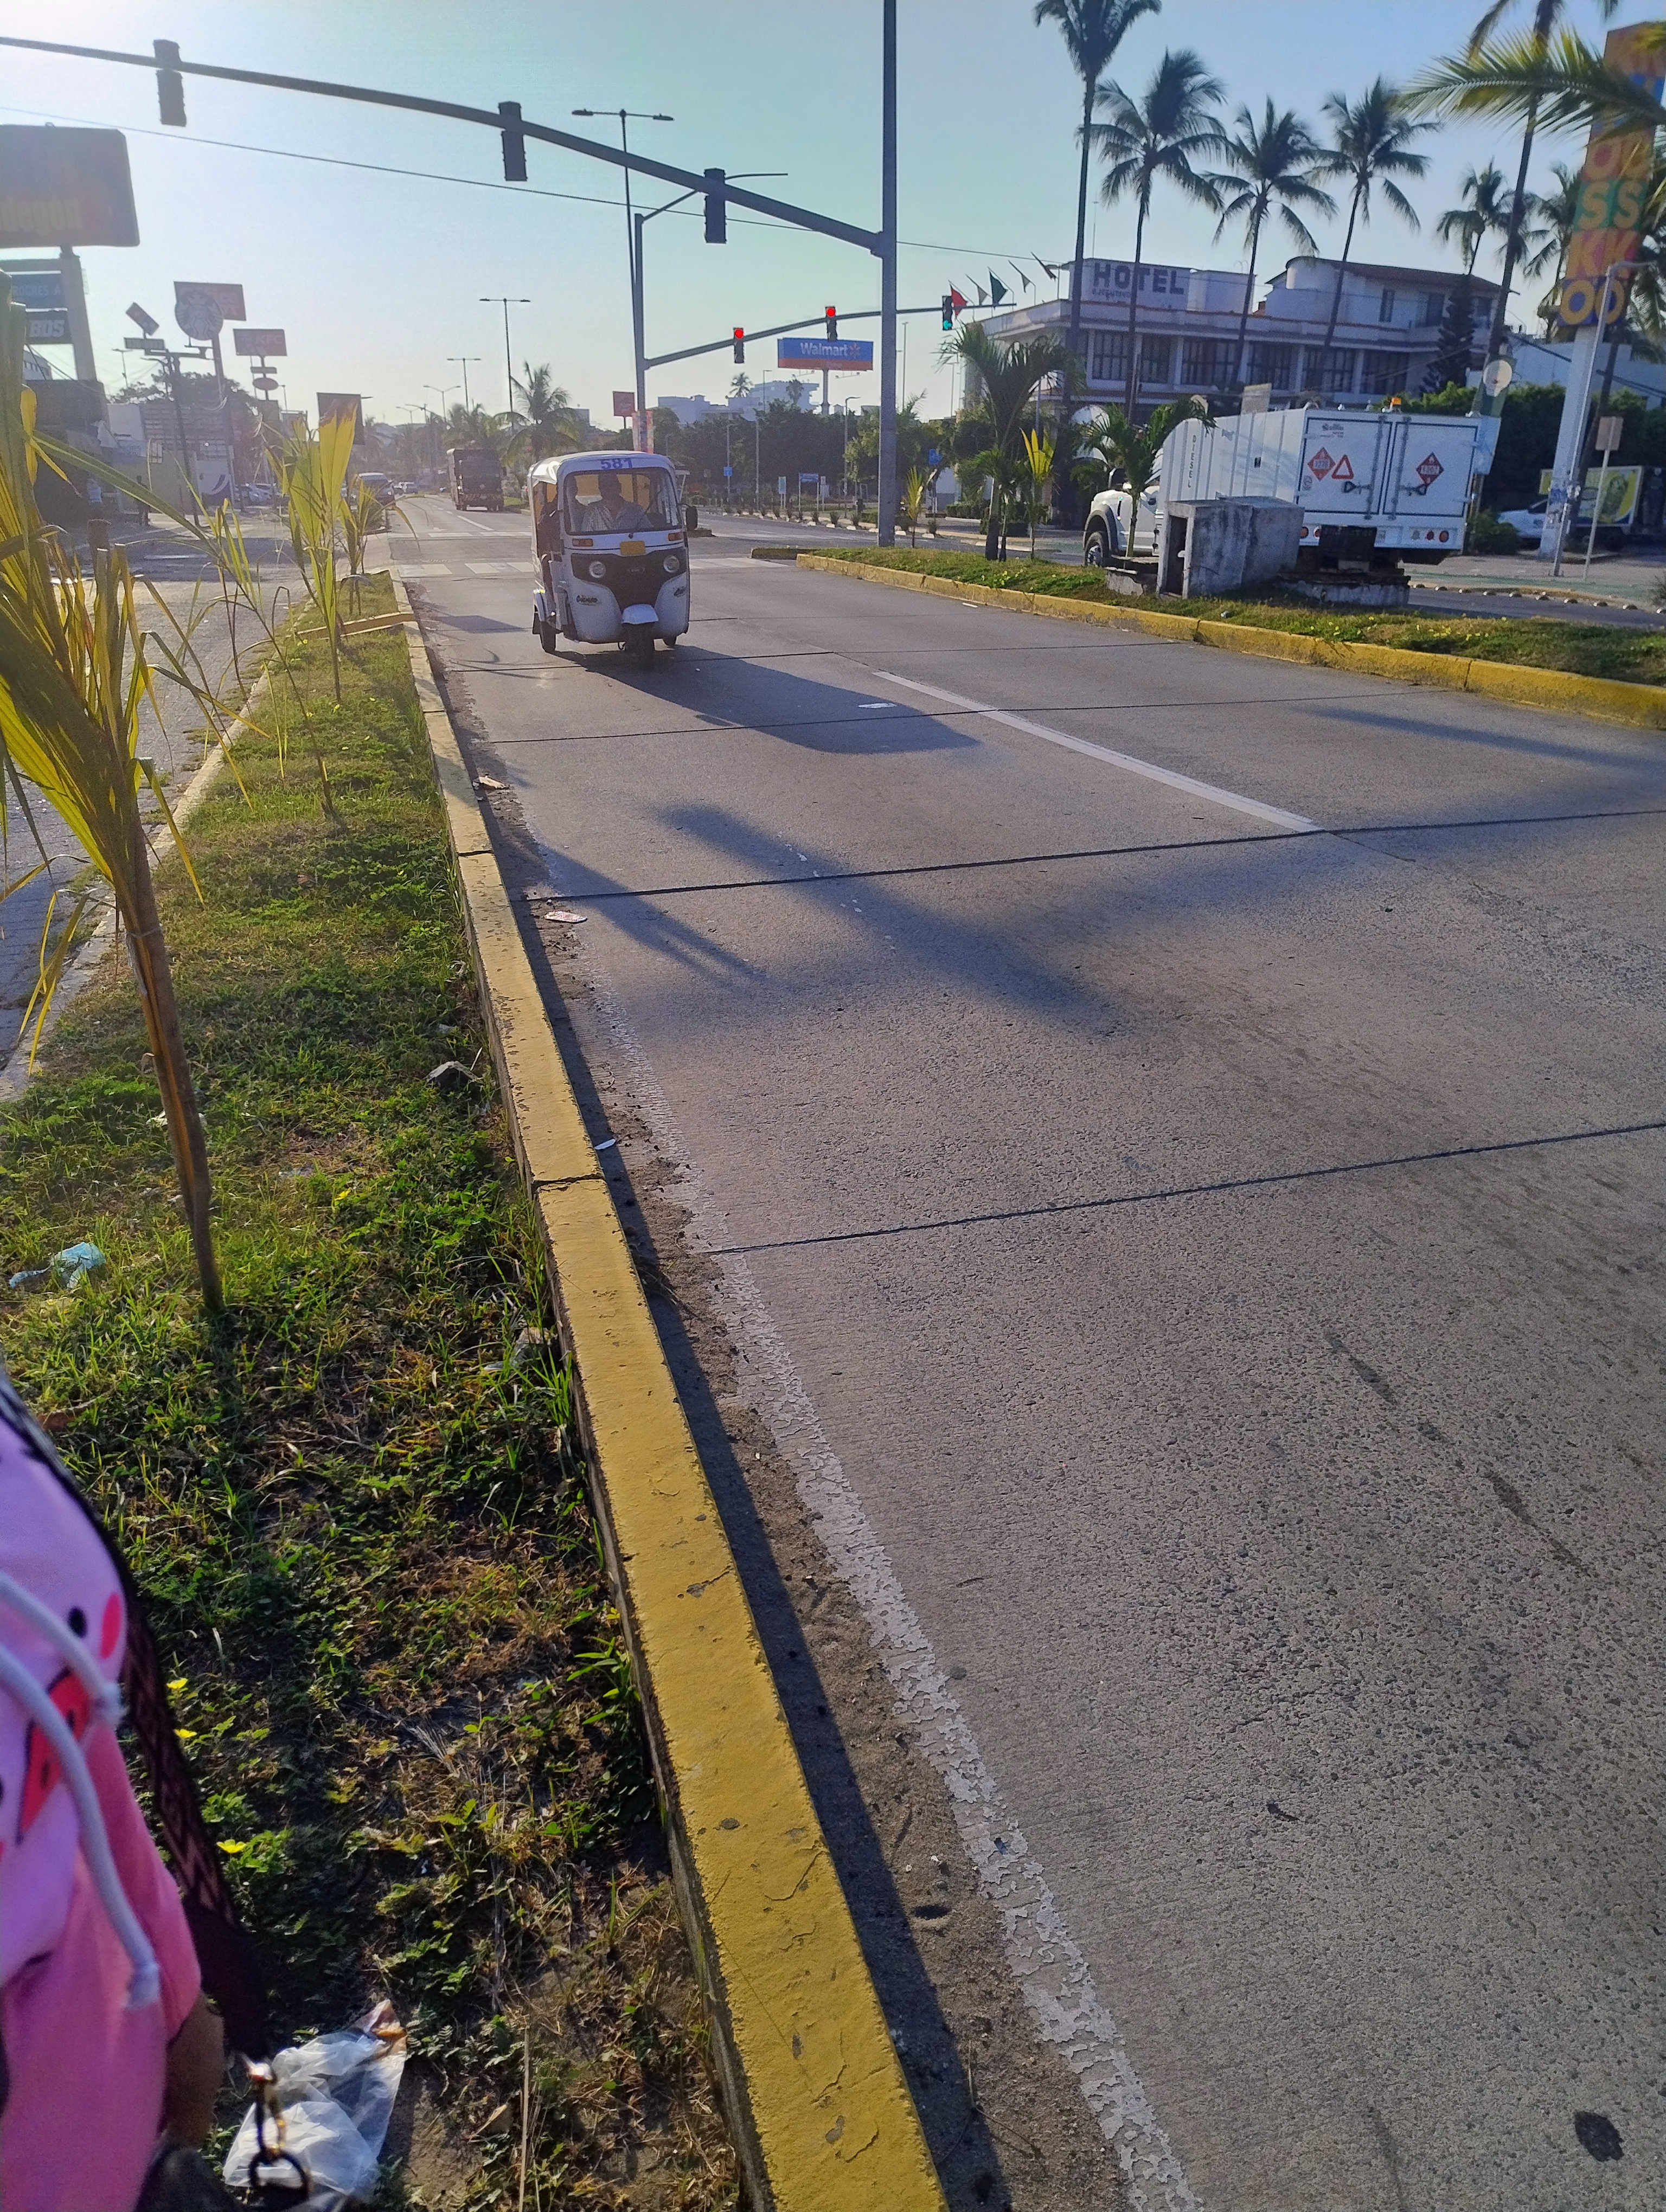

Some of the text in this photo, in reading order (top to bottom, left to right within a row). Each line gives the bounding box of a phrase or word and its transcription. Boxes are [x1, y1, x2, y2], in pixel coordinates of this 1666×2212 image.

[1093, 262, 1184, 295] HOTEL
[799, 342, 848, 357] Walmart
[601, 458, 632, 470] 581
[1188, 434, 1197, 488] DIESEL
